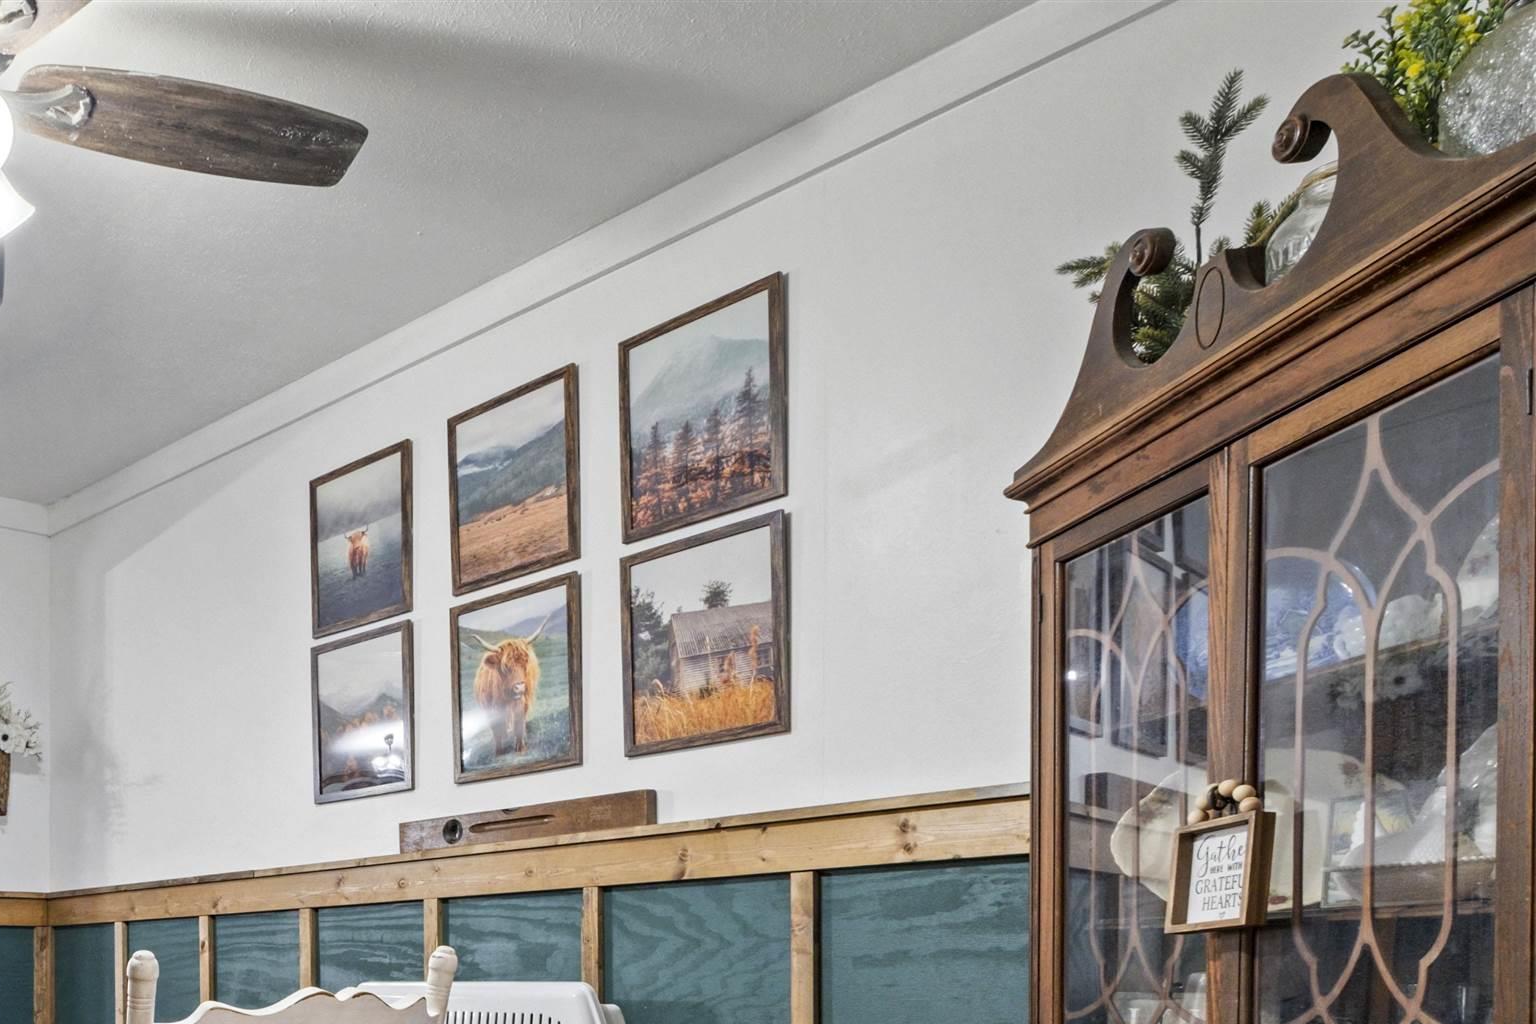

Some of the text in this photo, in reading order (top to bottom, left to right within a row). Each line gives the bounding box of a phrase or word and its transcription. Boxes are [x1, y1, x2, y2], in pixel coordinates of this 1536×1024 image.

[1196, 834, 1245, 878] Gathe
[1209, 865, 1224, 874] HERE
[1194, 873, 1243, 895] GRATEFU
[1201, 892, 1243, 911] HEARTS
